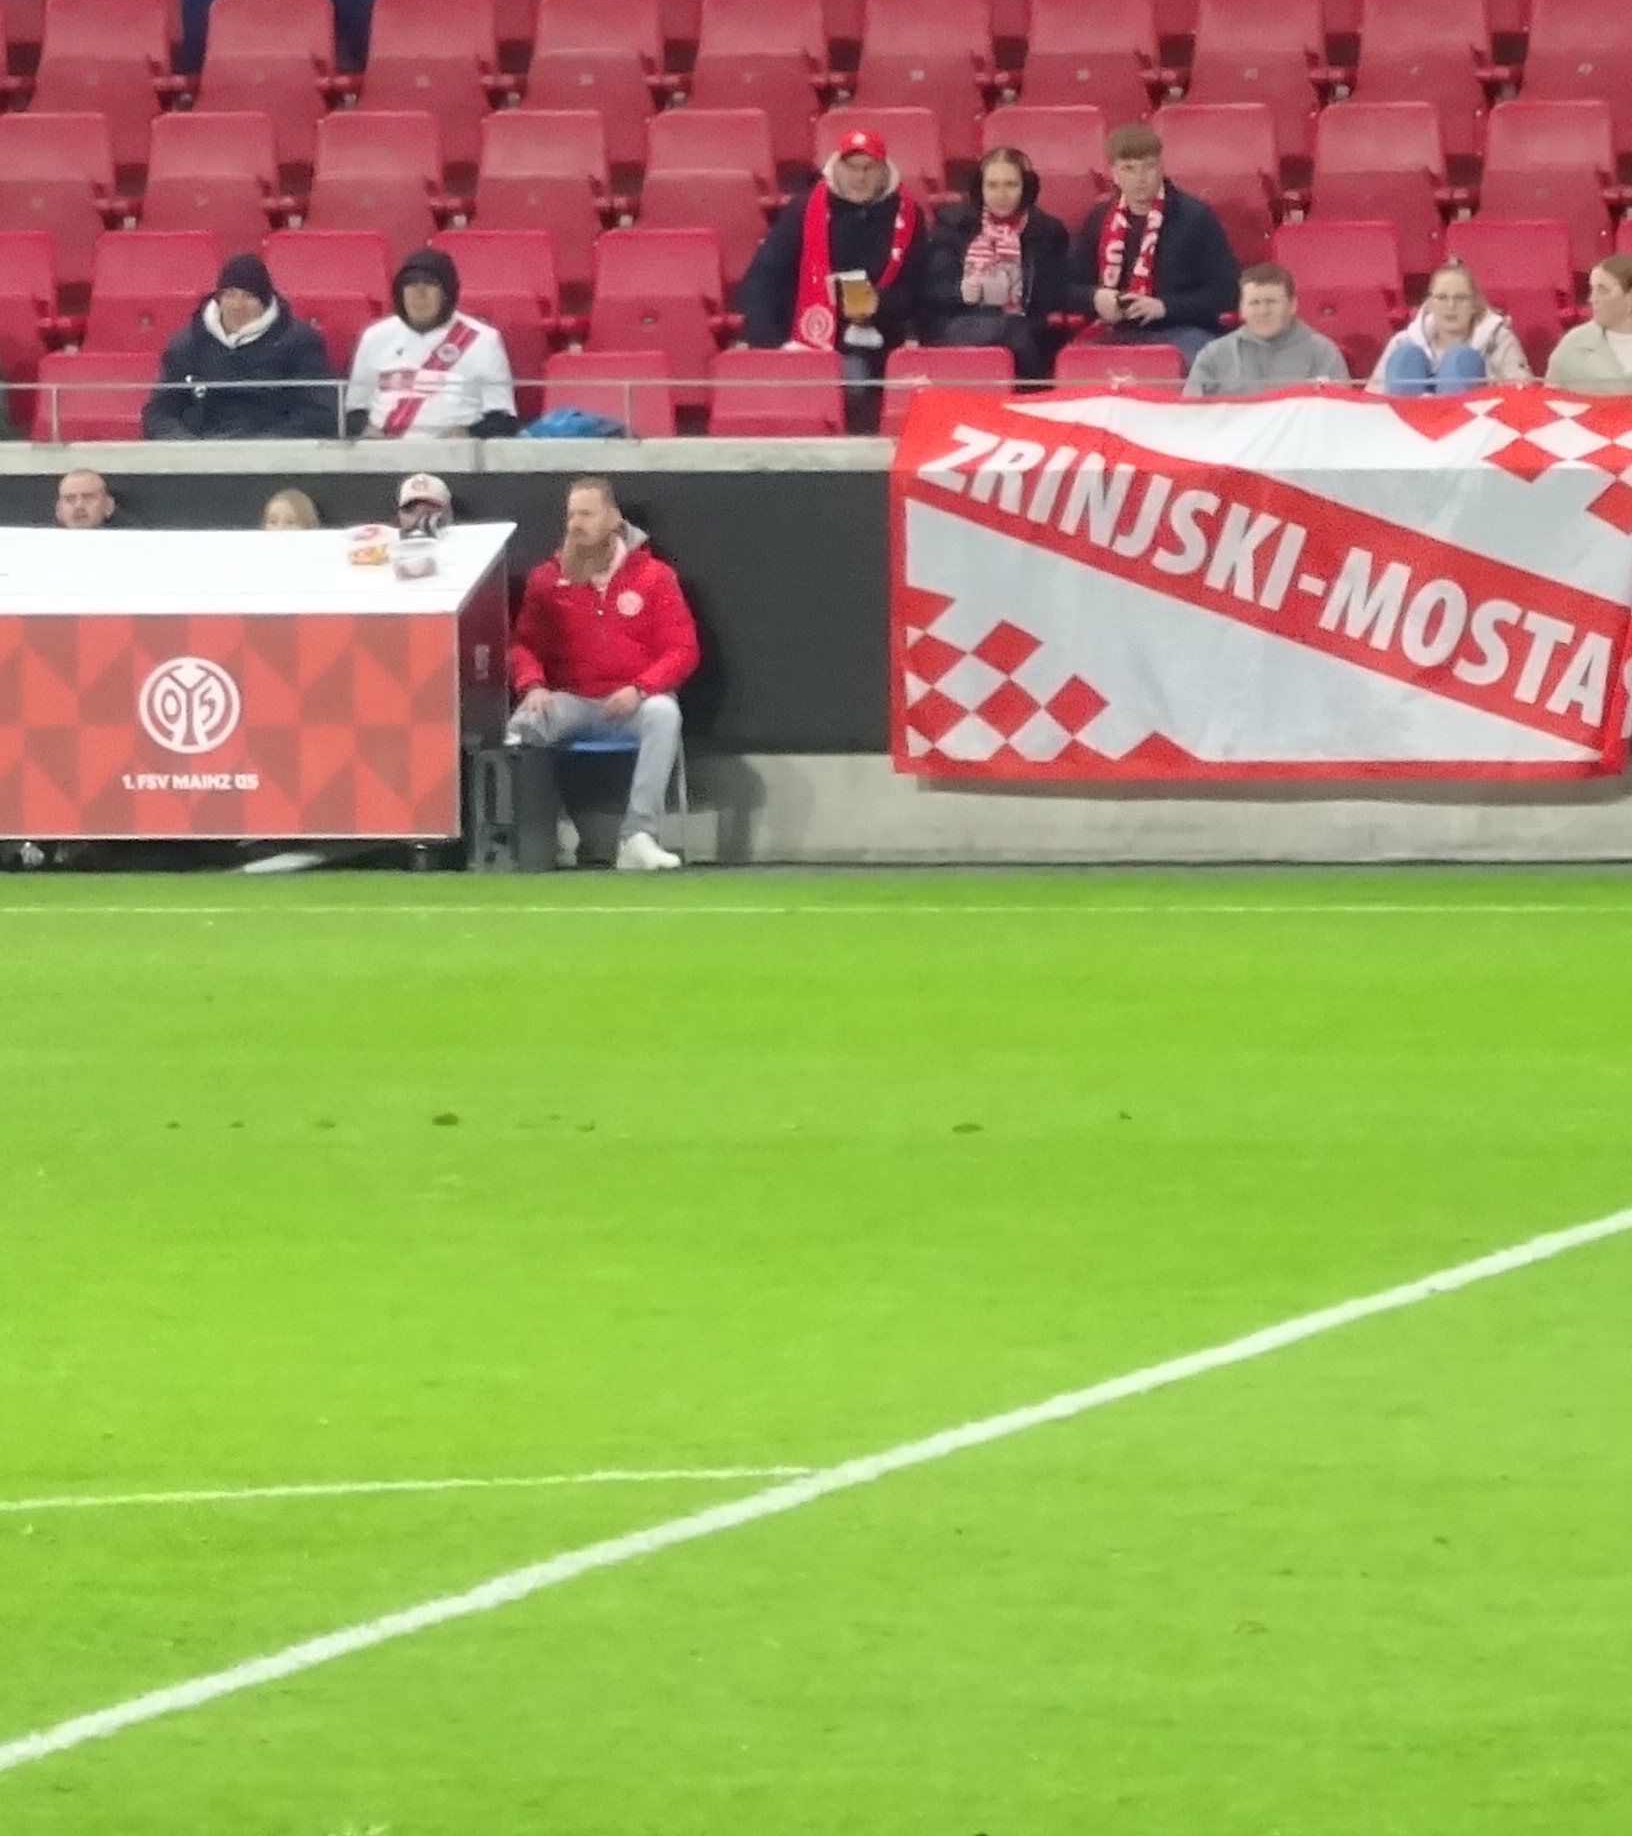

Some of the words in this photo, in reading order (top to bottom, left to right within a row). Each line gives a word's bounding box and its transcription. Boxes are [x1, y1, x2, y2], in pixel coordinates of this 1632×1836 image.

[137, 773, 170, 790] FSV
[172, 773, 232, 790] MAINZ
[234, 773, 260, 790] 05
